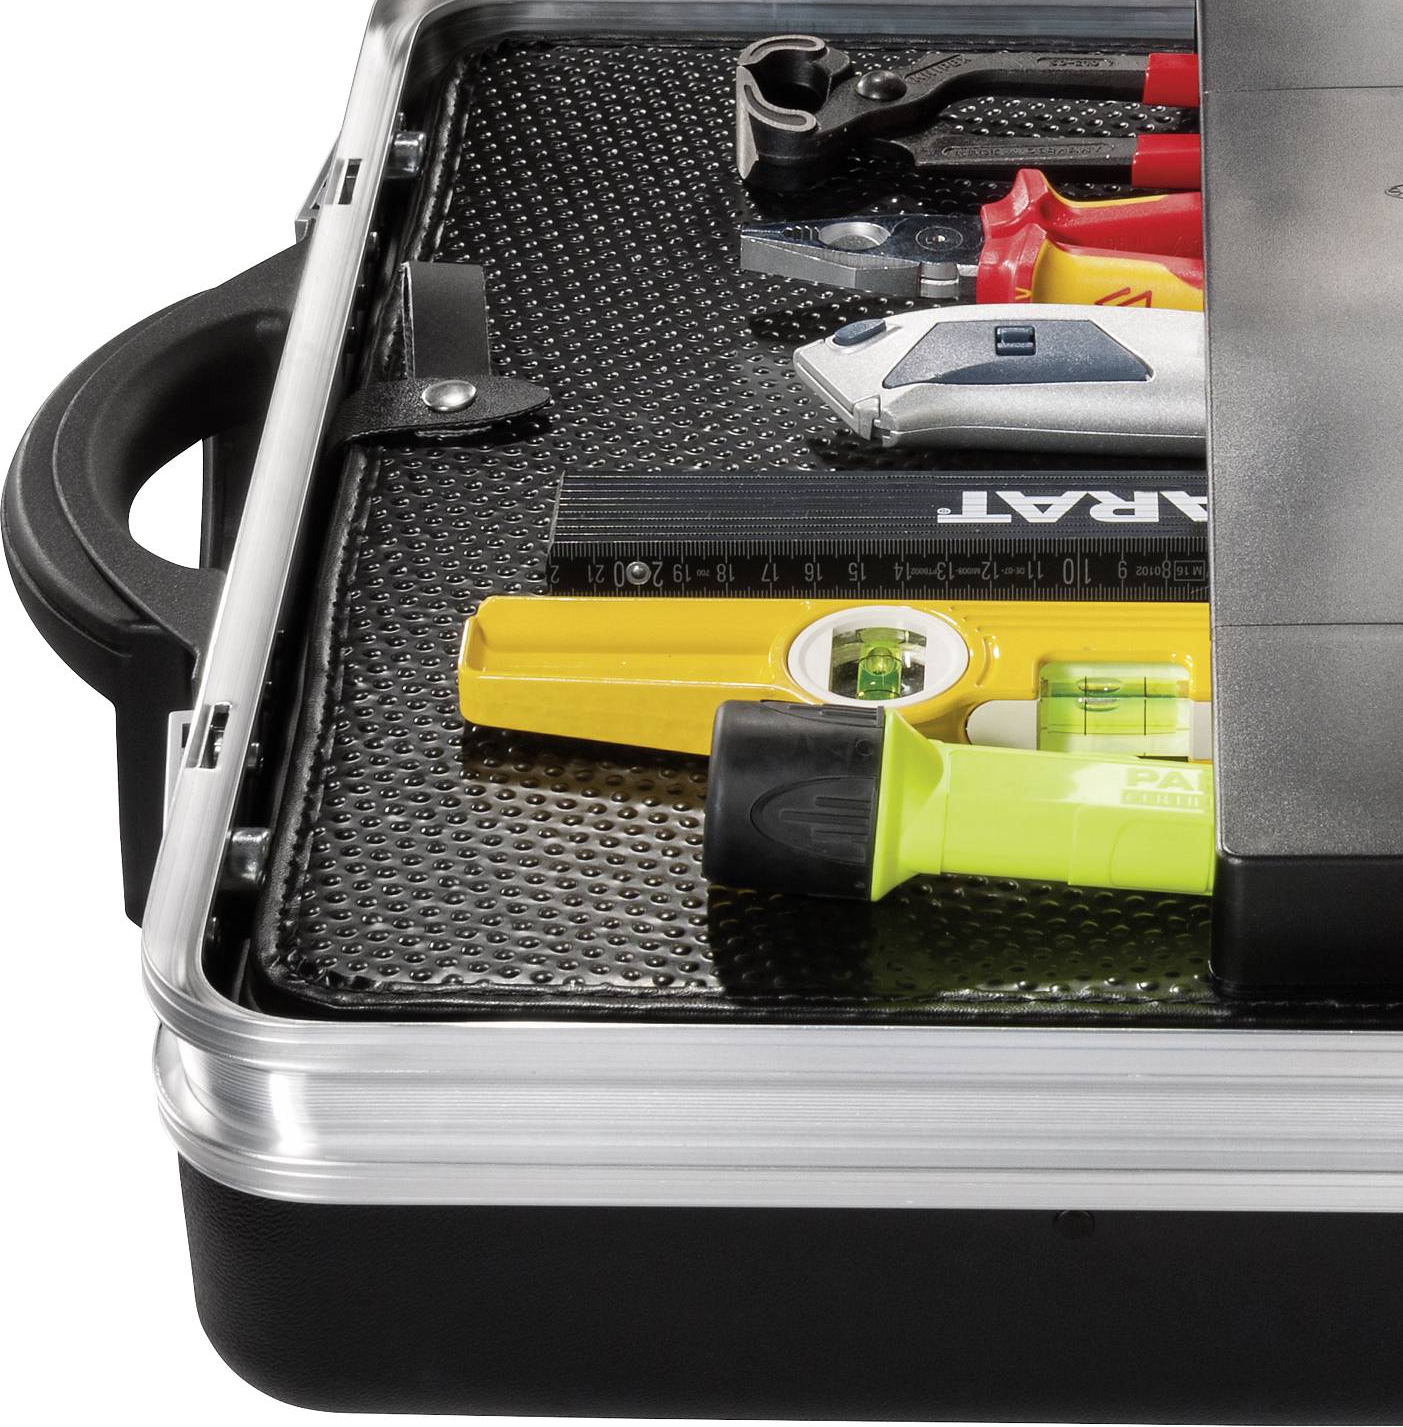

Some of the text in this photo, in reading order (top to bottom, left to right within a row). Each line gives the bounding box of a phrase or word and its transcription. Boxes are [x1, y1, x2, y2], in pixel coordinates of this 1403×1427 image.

[587, 564, 605, 583] 21
[673, 563, 692, 583] 19
[716, 563, 735, 583] 18
[761, 563, 780, 582] 17
[804, 562, 823, 582] 16
[848, 562, 867, 581] 15
[894, 561, 912, 581] 14
[936, 561, 955, 581] 13
[981, 561, 1000, 580] 12
[1028, 560, 1044, 580] 11
[1063, 558, 1092, 585] 10
